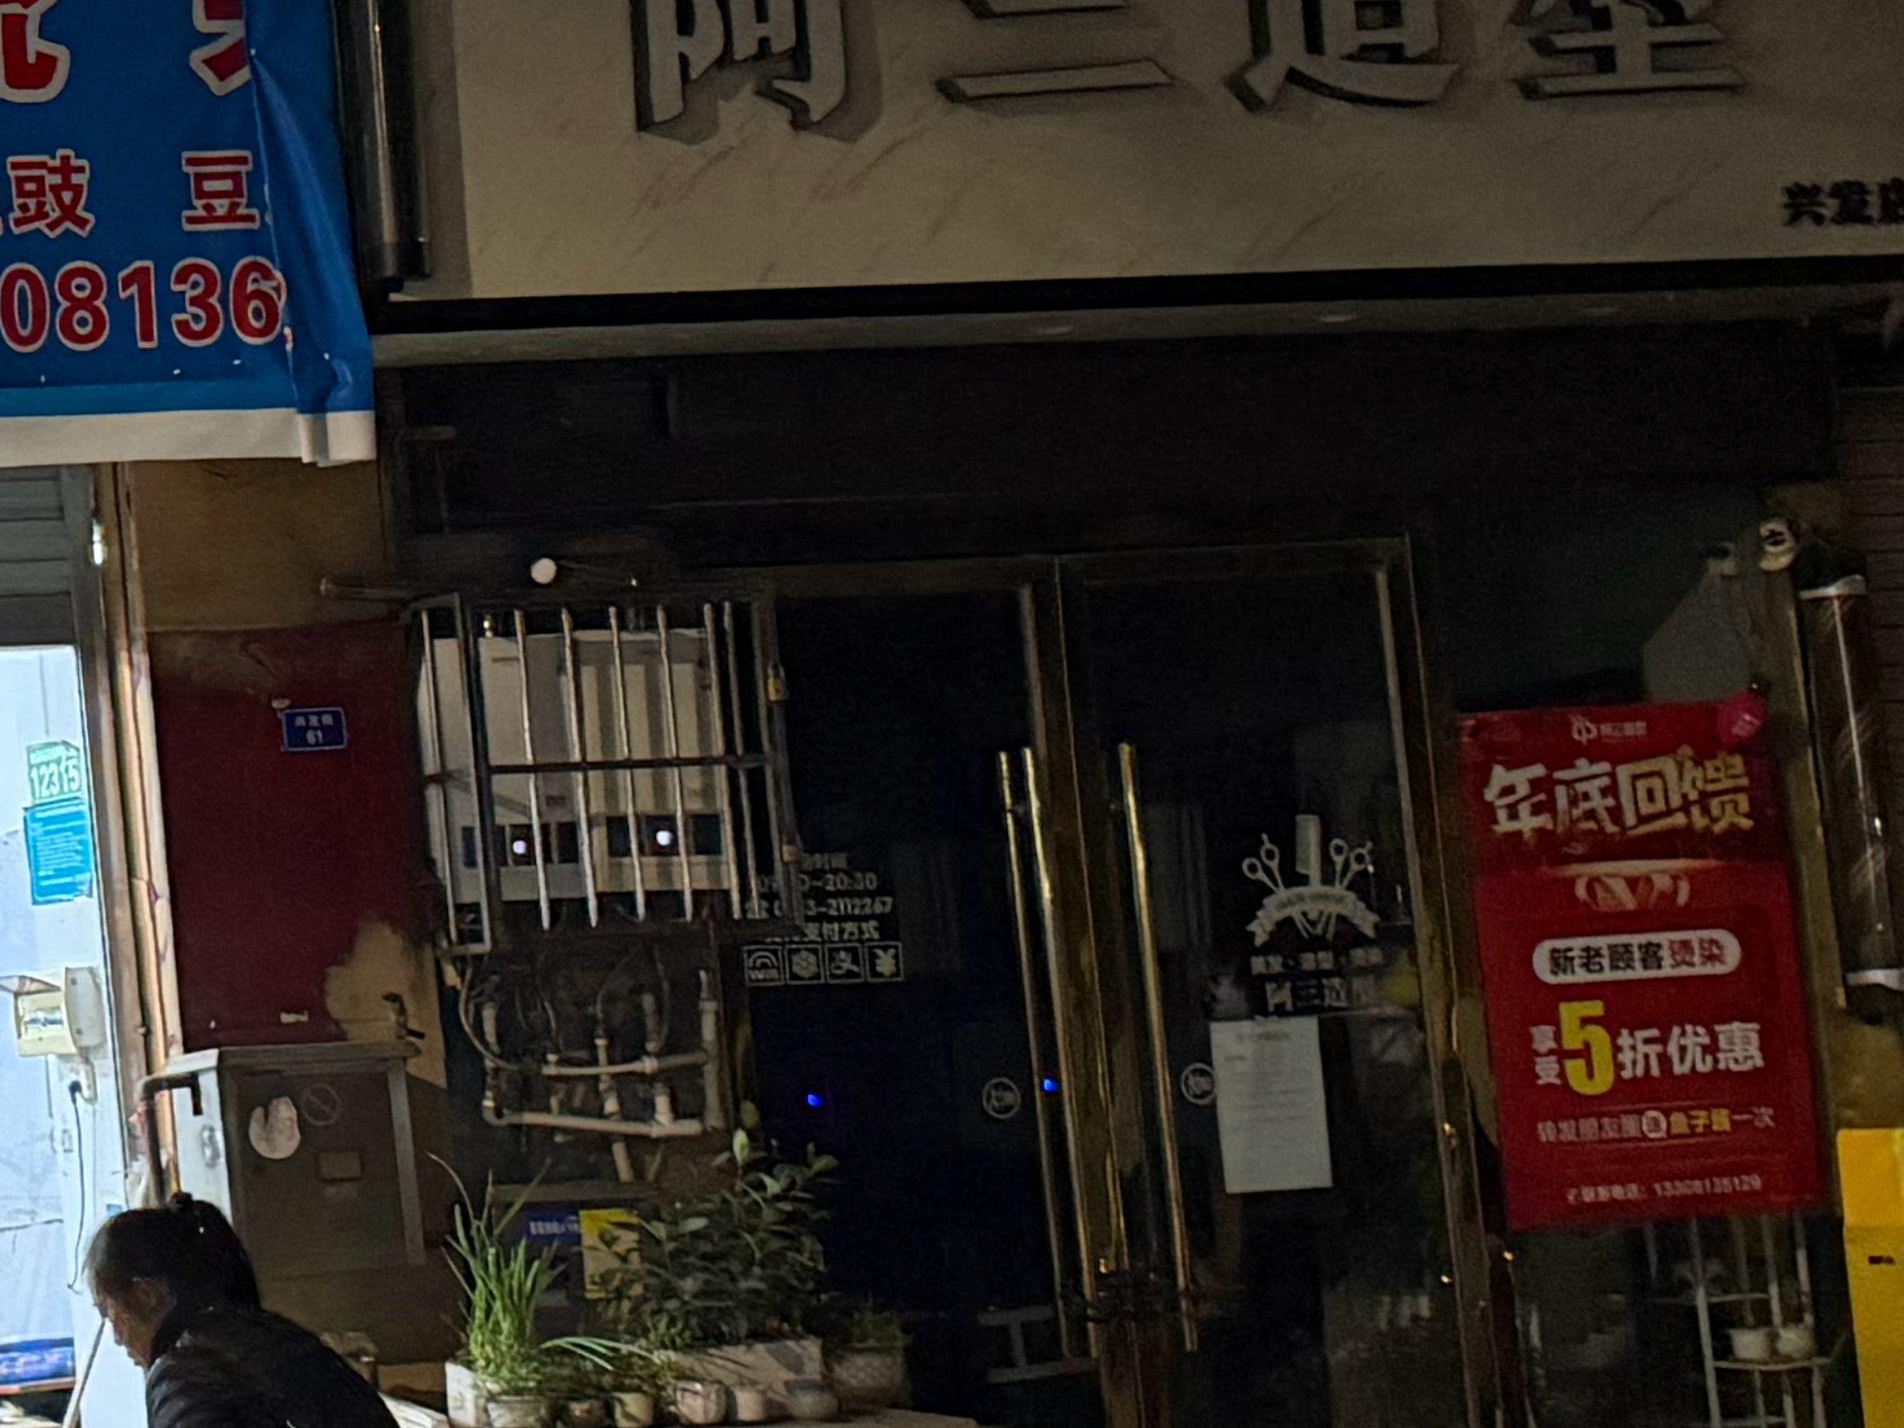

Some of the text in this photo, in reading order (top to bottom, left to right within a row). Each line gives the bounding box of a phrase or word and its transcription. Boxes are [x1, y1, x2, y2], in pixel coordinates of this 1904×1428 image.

[1482, 743, 1754, 845] 年底回馈
[1550, 937, 1726, 976] 新老顾客烫染
